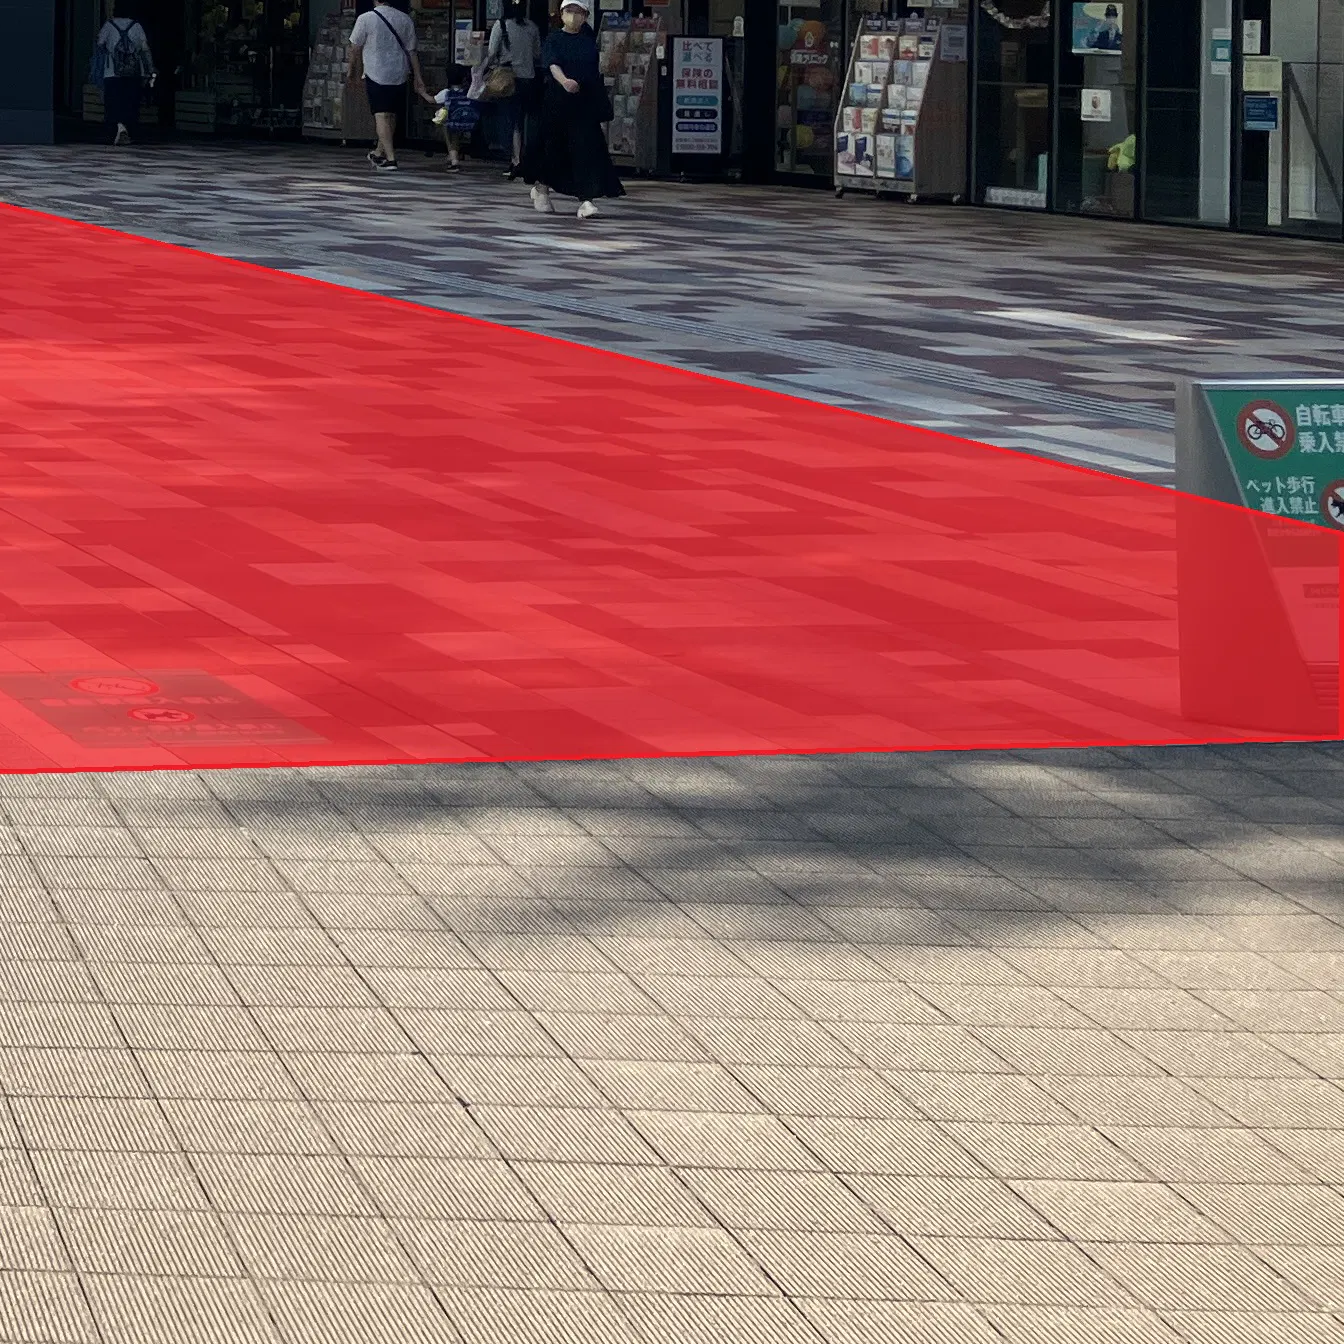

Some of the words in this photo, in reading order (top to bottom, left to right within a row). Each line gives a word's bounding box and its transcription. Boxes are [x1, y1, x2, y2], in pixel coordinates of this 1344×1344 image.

[1247, 476, 1315, 494] ペット歩行
[1260, 497, 1319, 514] 進入禁止
